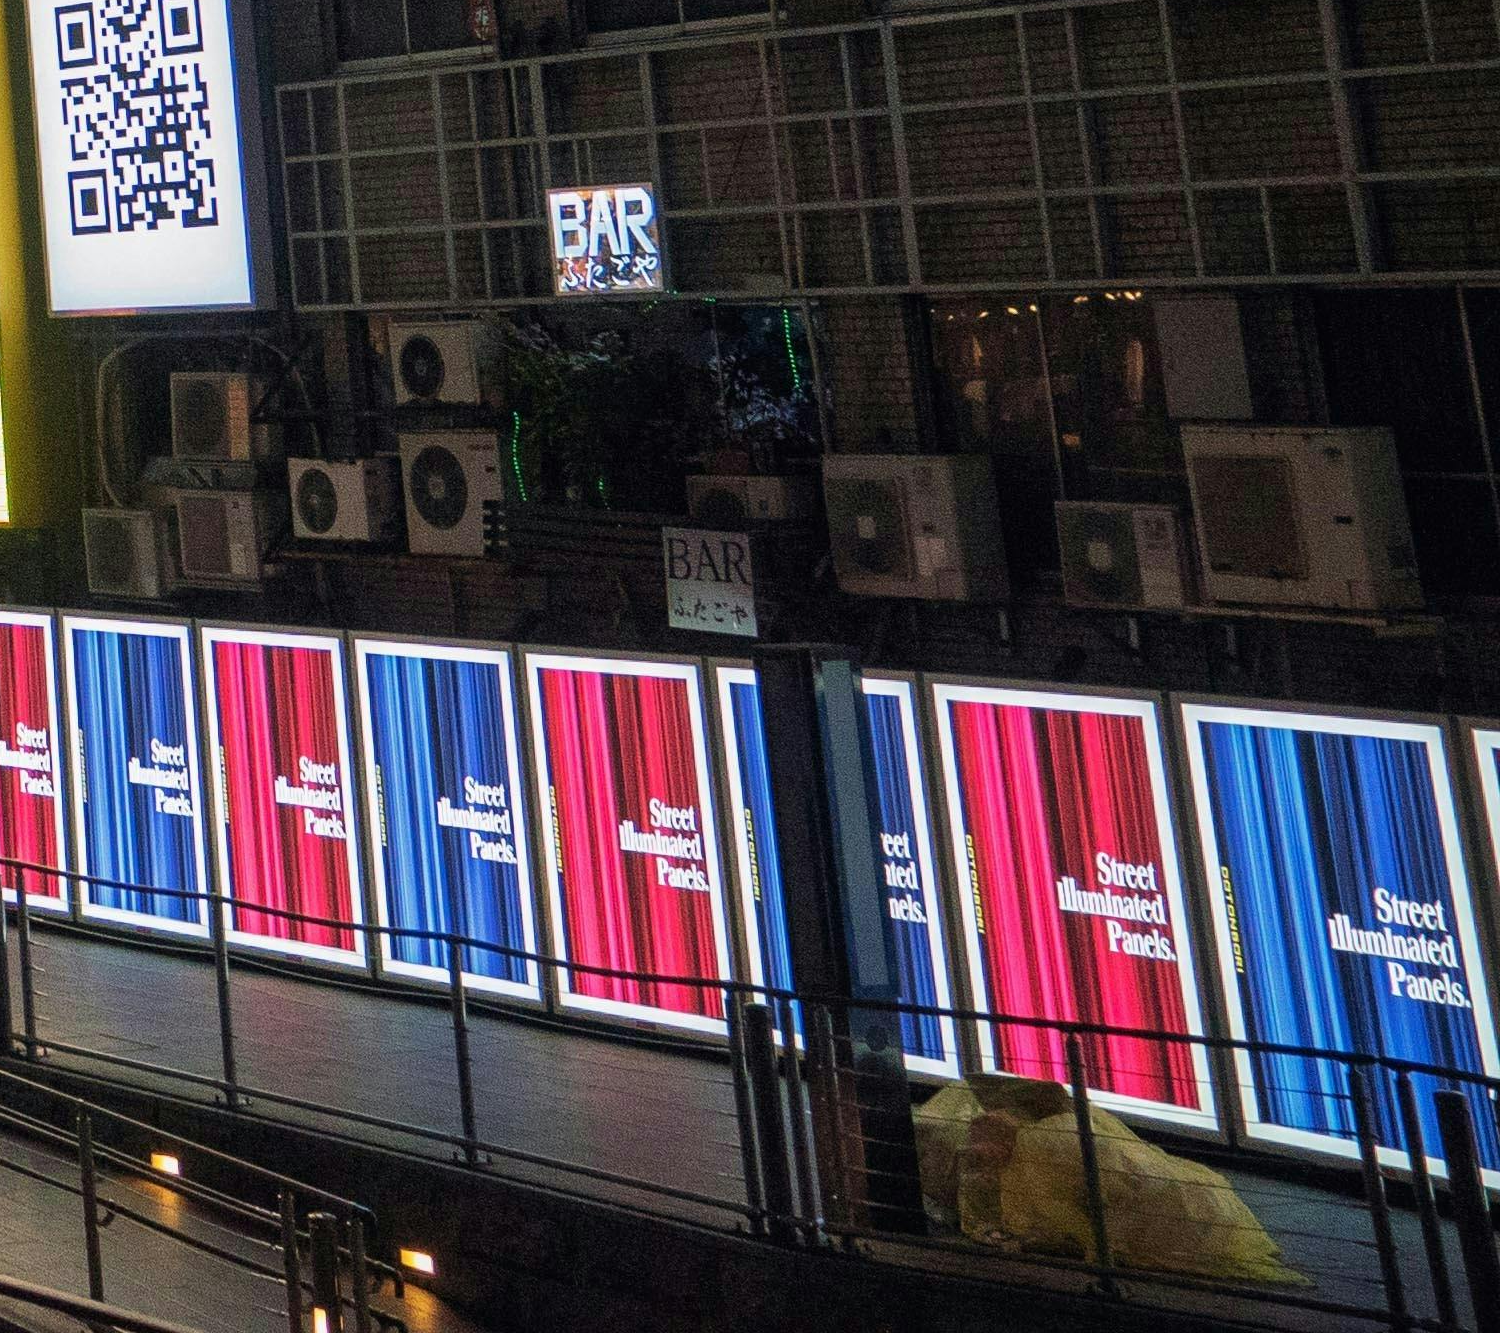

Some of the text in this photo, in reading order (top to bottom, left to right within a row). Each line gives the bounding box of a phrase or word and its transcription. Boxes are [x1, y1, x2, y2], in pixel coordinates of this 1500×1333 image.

[550, 186, 657, 259] BAR
[559, 254, 658, 290] ふたごや
[667, 538, 751, 586] BAR
[674, 597, 749, 627] ふたごや
[649, 797, 695, 834] Street
[1095, 851, 1157, 892] Street
[1372, 886, 1448, 933] Street
[1107, 919, 1178, 962] Panels.
[1386, 957, 1472, 1010] Panels.
